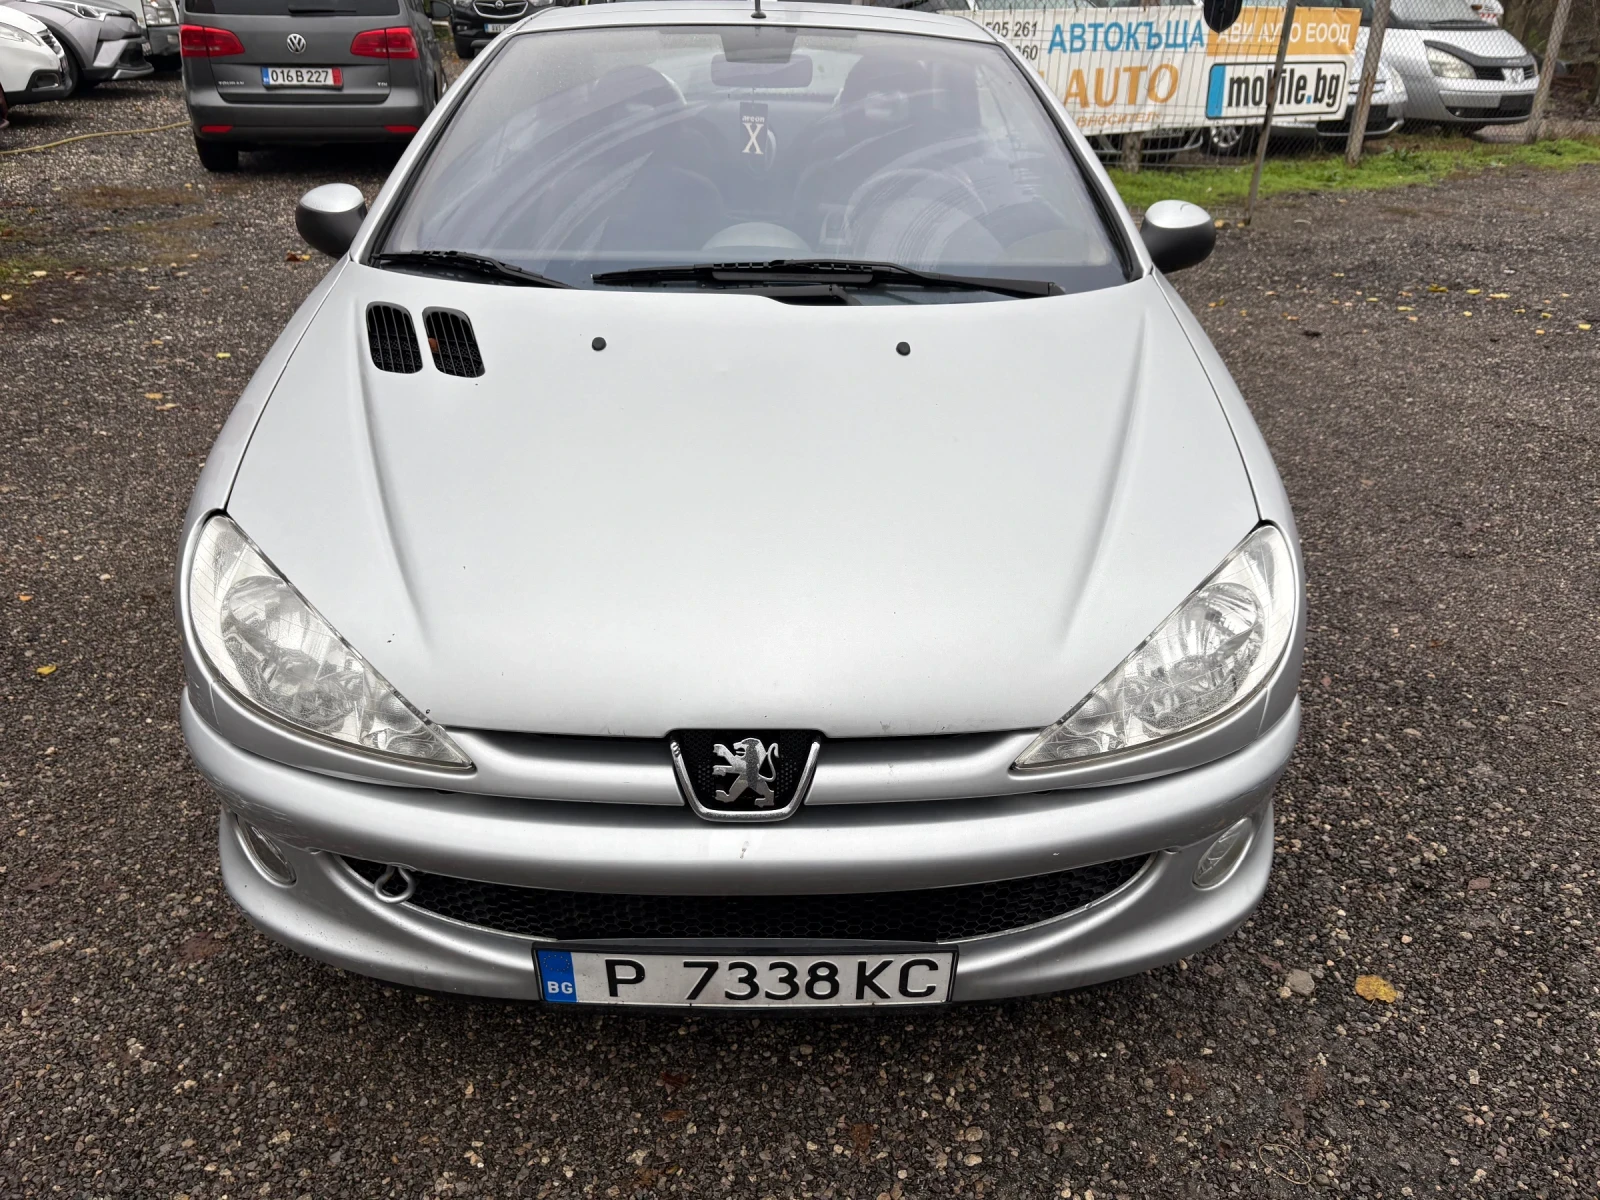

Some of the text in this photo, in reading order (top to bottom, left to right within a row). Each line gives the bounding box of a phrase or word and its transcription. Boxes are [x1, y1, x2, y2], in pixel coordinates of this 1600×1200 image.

[1014, 21, 1038, 38] 261
[1047, 19, 1205, 55] АВТОКЪЩА
[1258, 22, 1302, 43] АУО
[1305, 22, 1351, 46] ЕООД
[270, 69, 294, 83] 016
[295, 70, 304, 83] B
[306, 70, 329, 83] 227
[1063, 63, 1180, 109] AUTO
[742, 115, 765, 123] areon
[742, 122, 764, 155] X
[547, 980, 574, 995] BG
[604, 958, 940, 1001] P 7338 KC
